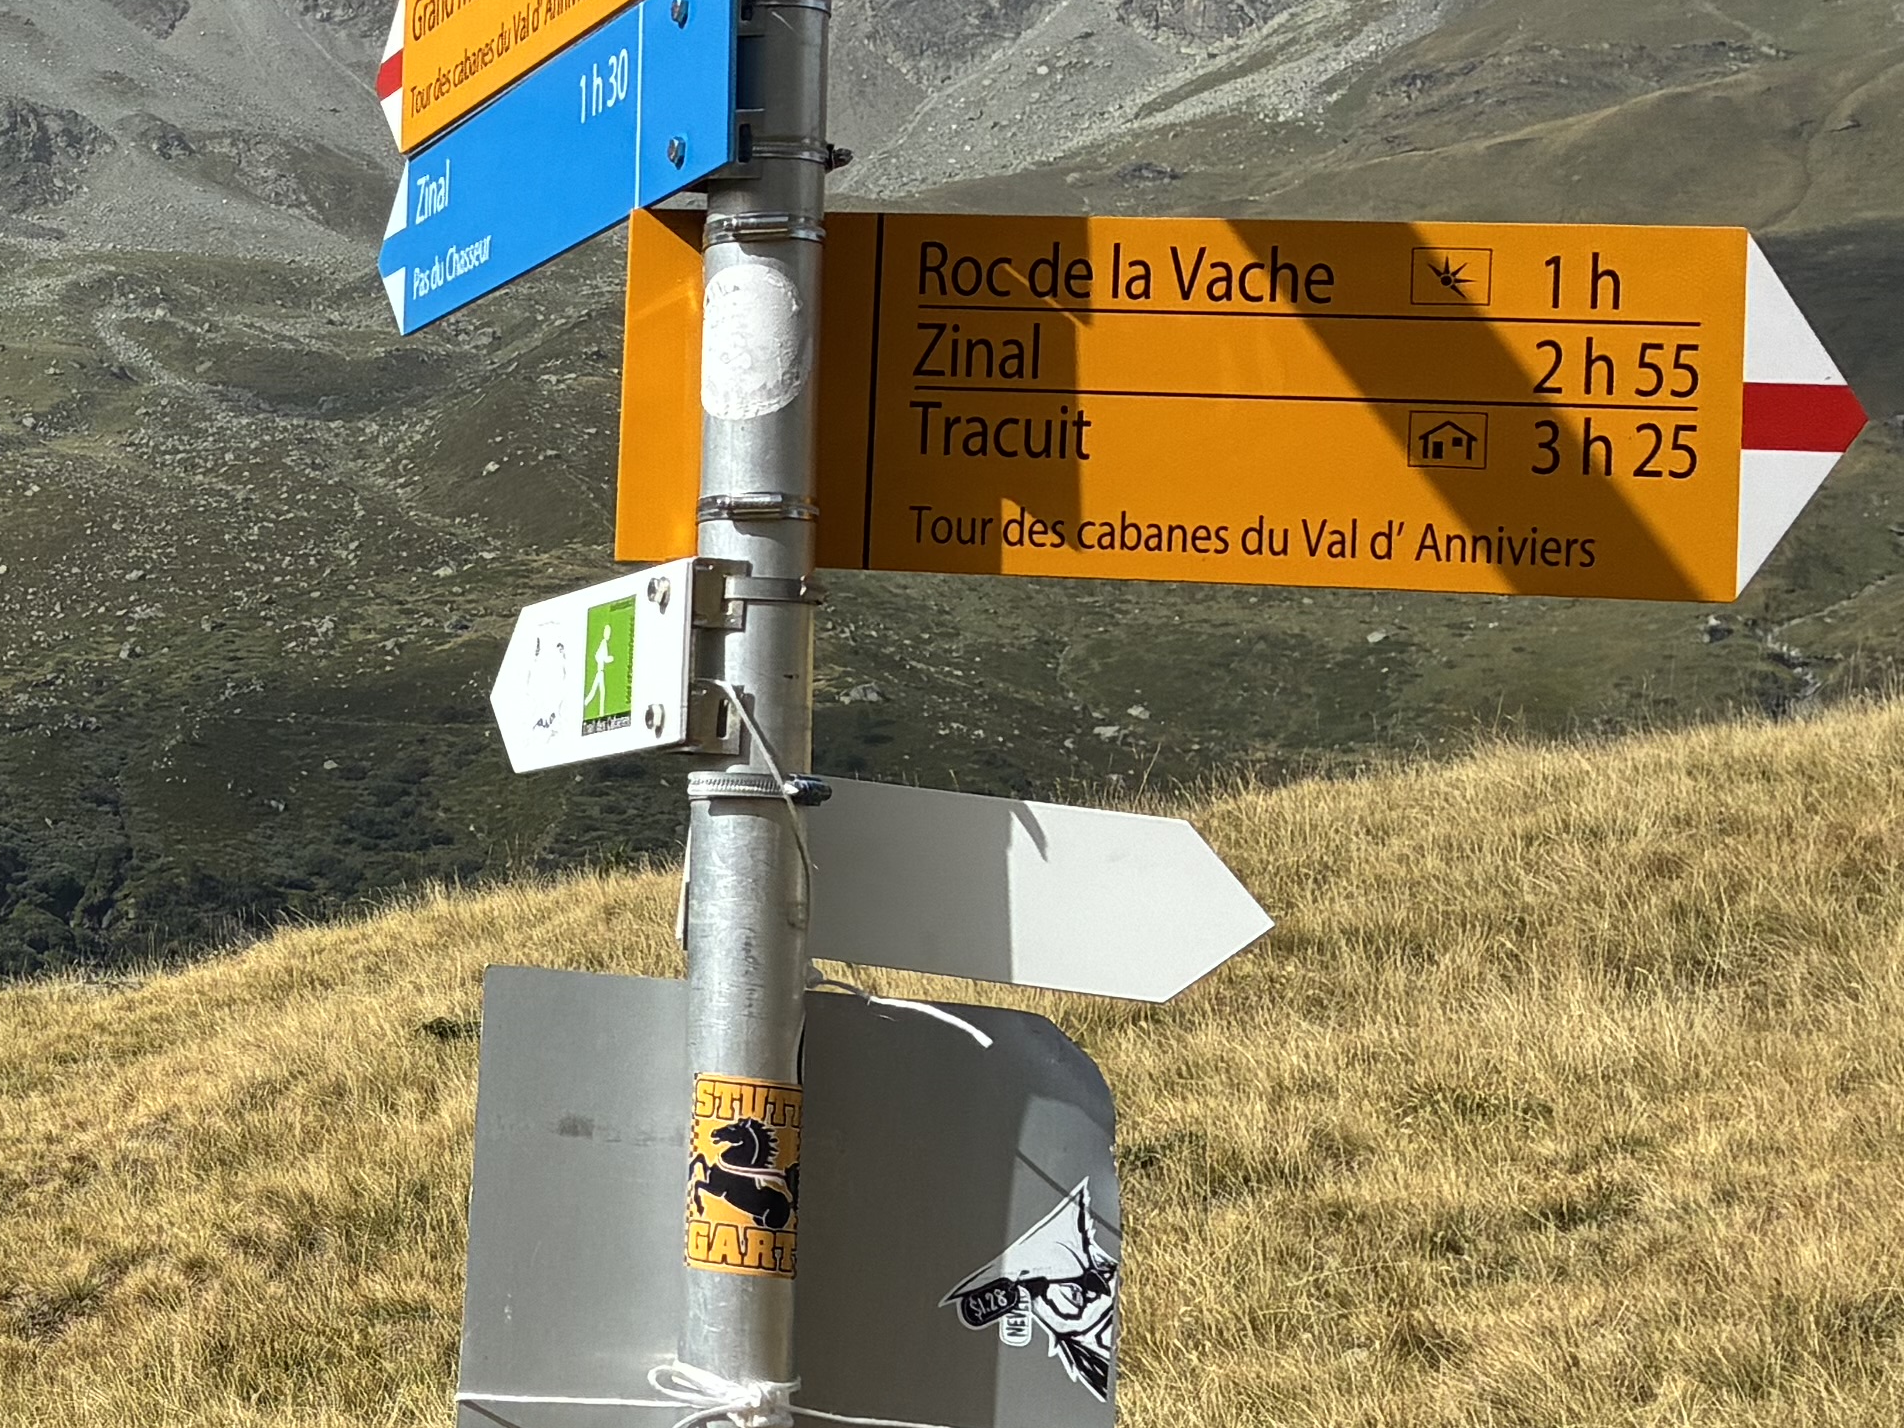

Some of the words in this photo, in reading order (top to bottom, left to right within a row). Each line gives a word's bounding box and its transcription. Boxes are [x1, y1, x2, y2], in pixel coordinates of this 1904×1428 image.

[410, 82, 433, 118] Tour
[433, 67, 451, 102] des
[453, 48, 495, 88] cabanes
[496, 22, 511, 58] du
[513, 2, 530, 45] Val
[415, 158, 450, 225] Zinal
[579, 75, 586, 124] 1
[592, 63, 603, 116] h
[606, 48, 628, 108] 30
[413, 267, 430, 300] Pas
[430, 255, 444, 290] du
[445, 234, 492, 281] Chasseur
[918, 240, 1012, 298] Roc
[1028, 241, 1093, 299] de
[1111, 242, 1153, 300] la
[1169, 245, 1335, 304] Vache
[1544, 255, 1562, 309] 1
[1590, 252, 1622, 311] h
[913, 322, 1040, 380] Zinal
[1533, 339, 1563, 395] 2
[1584, 336, 1615, 397] h
[1635, 342, 1700, 399] 55
[909, 400, 1092, 460] Tracuit
[1531, 419, 1561, 476] 3
[1582, 417, 1613, 478] h
[1633, 422, 1698, 480] 25
[909, 504, 994, 546] Tour
[1002, 507, 1065, 549] des
[1076, 510, 1230, 555] cabanes
[1241, 515, 1289, 557] du
[1302, 518, 1357, 560] Val
[1414, 523, 1597, 568] Anniviers
[686, 1220, 797, 1274] GART
